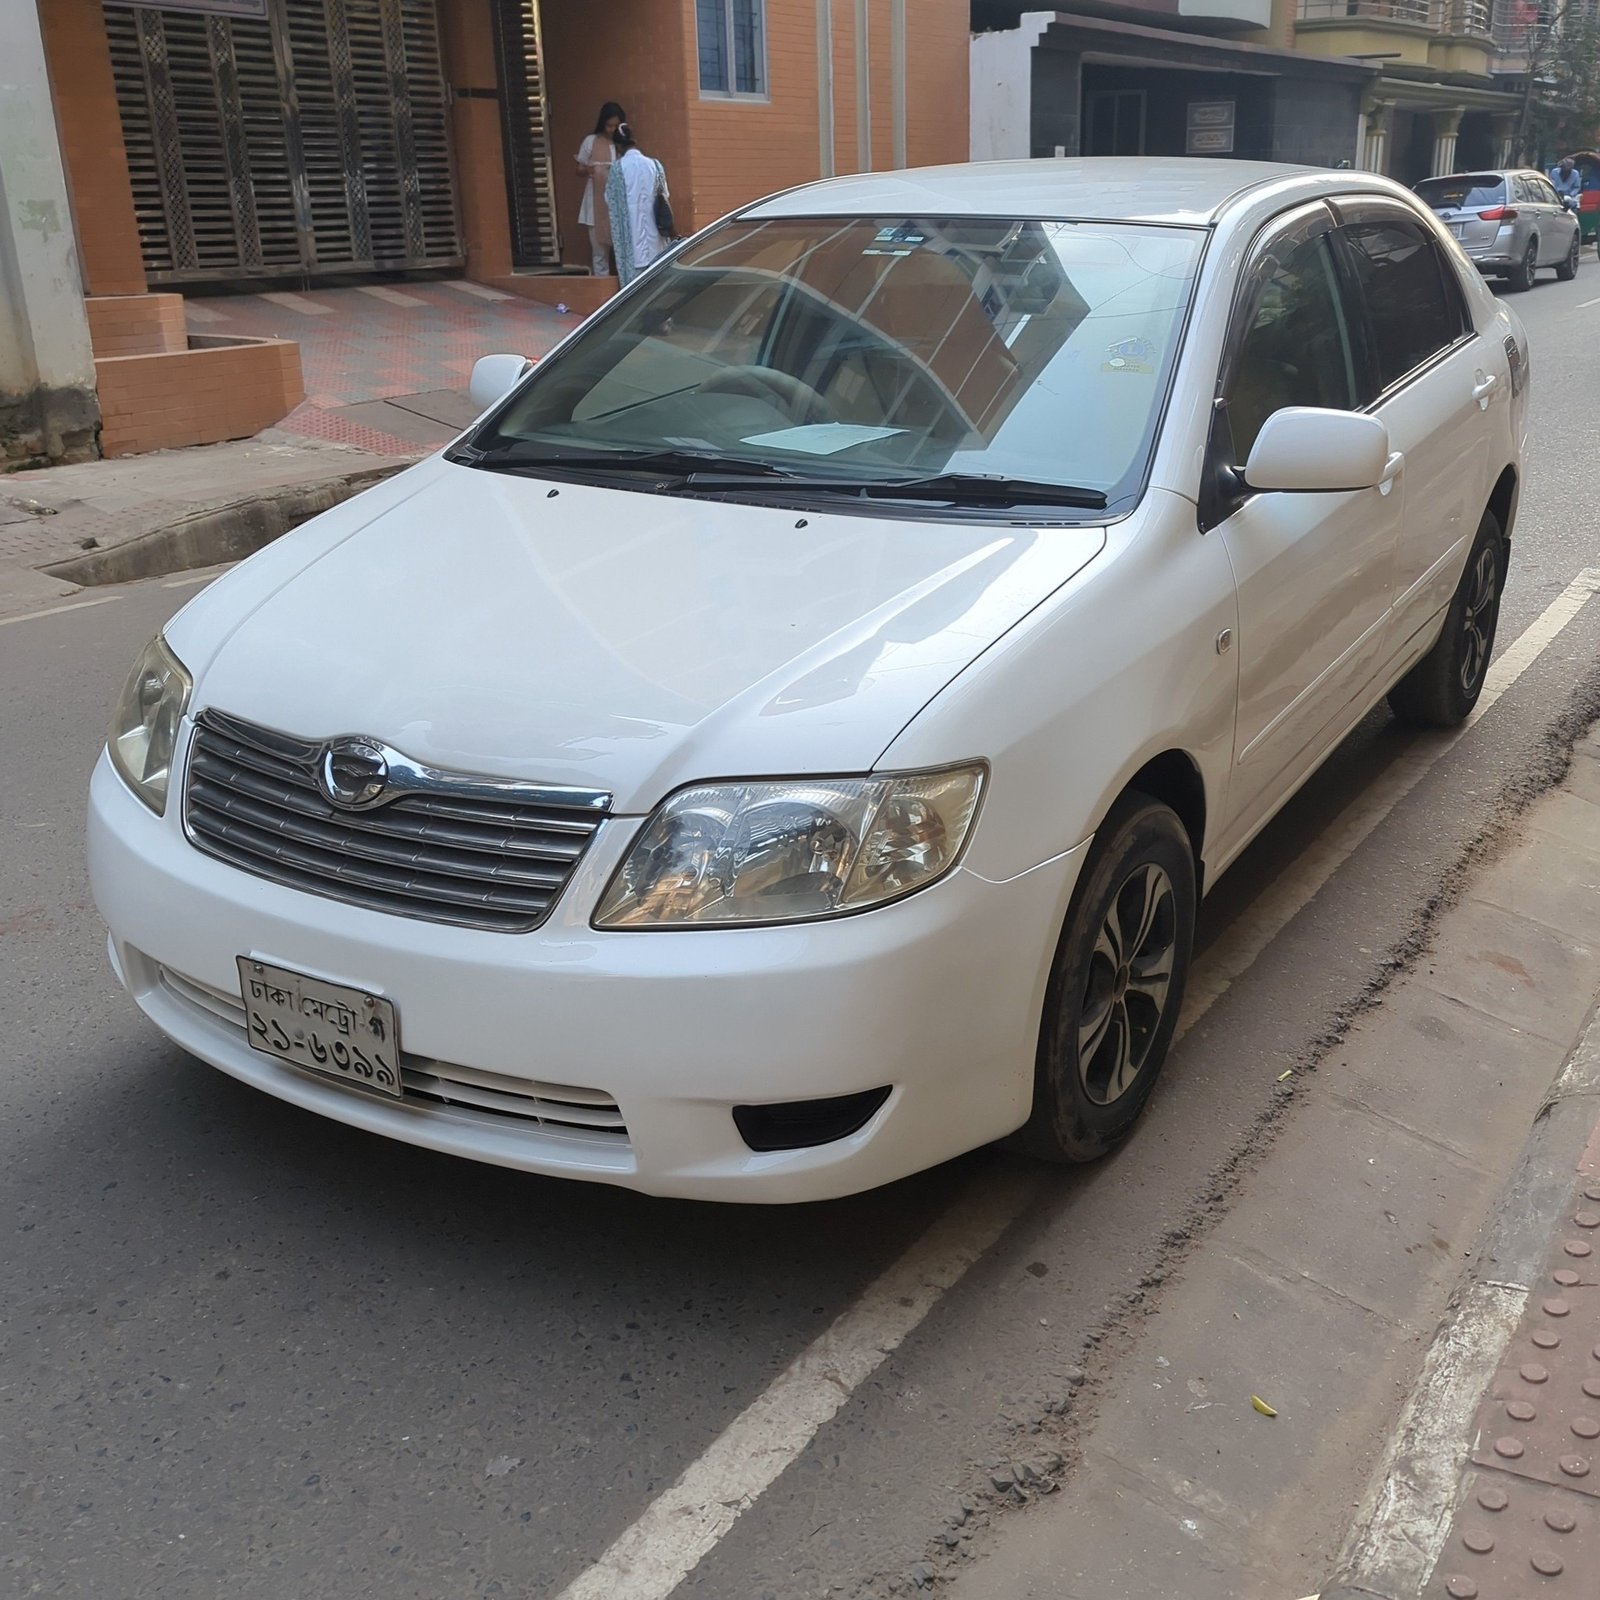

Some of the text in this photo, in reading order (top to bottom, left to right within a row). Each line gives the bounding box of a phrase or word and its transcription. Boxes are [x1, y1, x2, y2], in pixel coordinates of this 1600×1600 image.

[248, 978, 294, 1010] ঢাকা
[301, 996, 359, 1038] মেট্রো
[252, 1011, 395, 1086] ২১-৬৩৯৯
